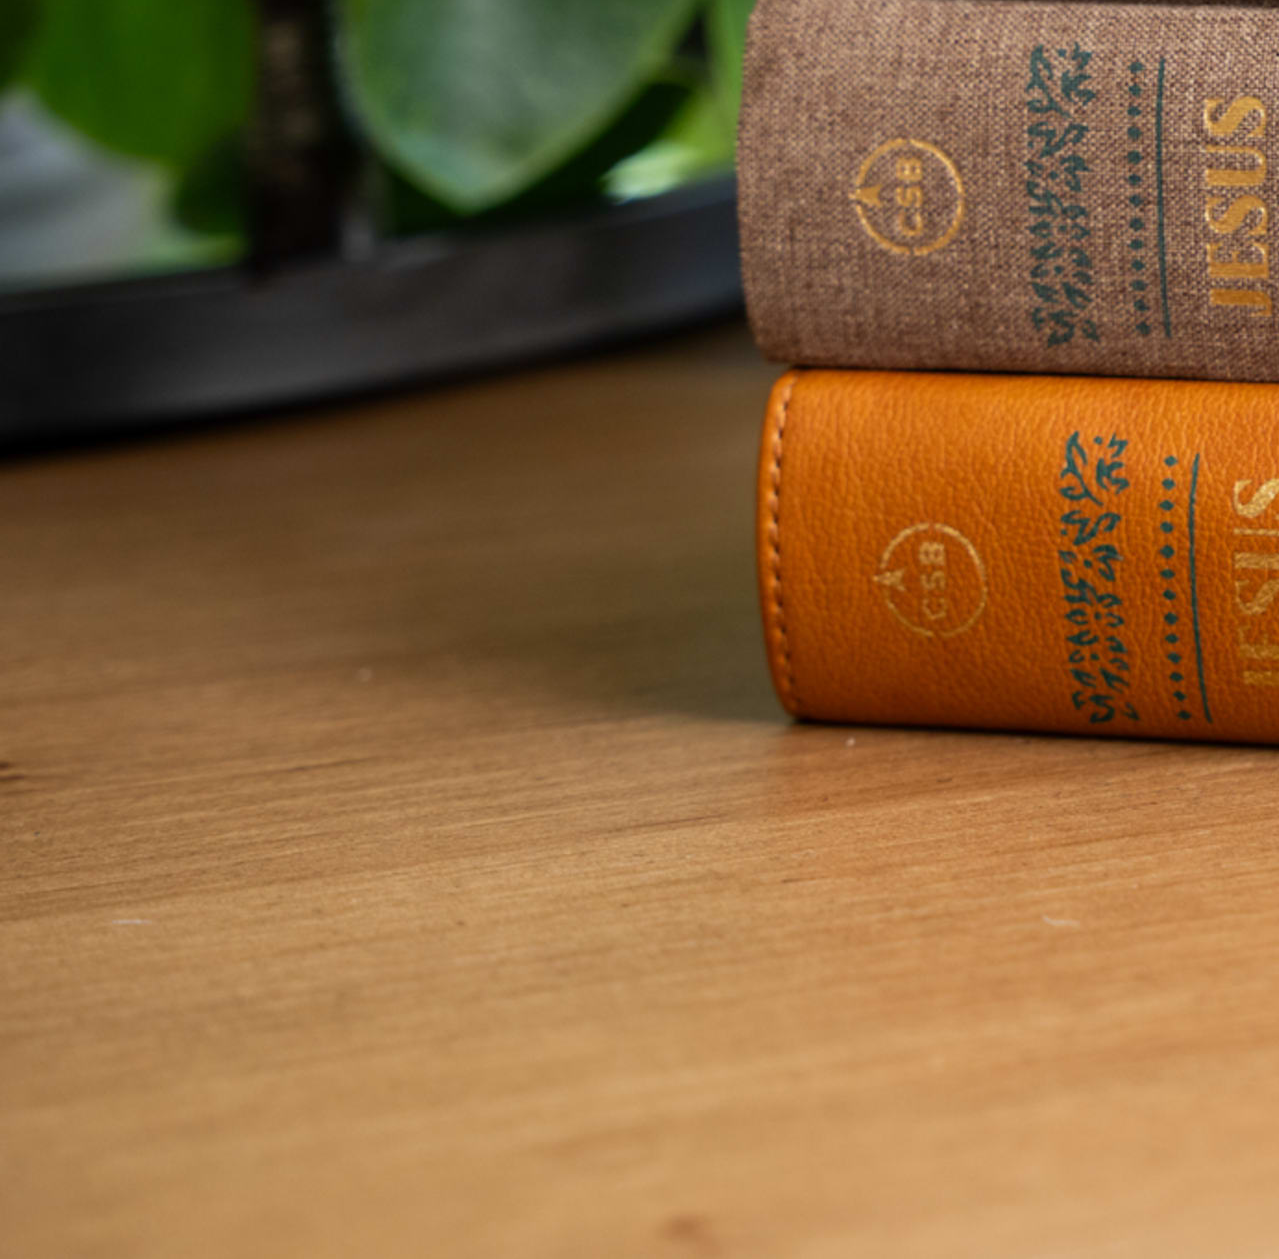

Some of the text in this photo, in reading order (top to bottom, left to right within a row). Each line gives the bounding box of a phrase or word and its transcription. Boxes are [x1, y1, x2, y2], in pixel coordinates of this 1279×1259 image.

[893, 157, 924, 238] CSB
[1204, 95, 1273, 316] JESUS
[921, 542, 951, 619] CSB
